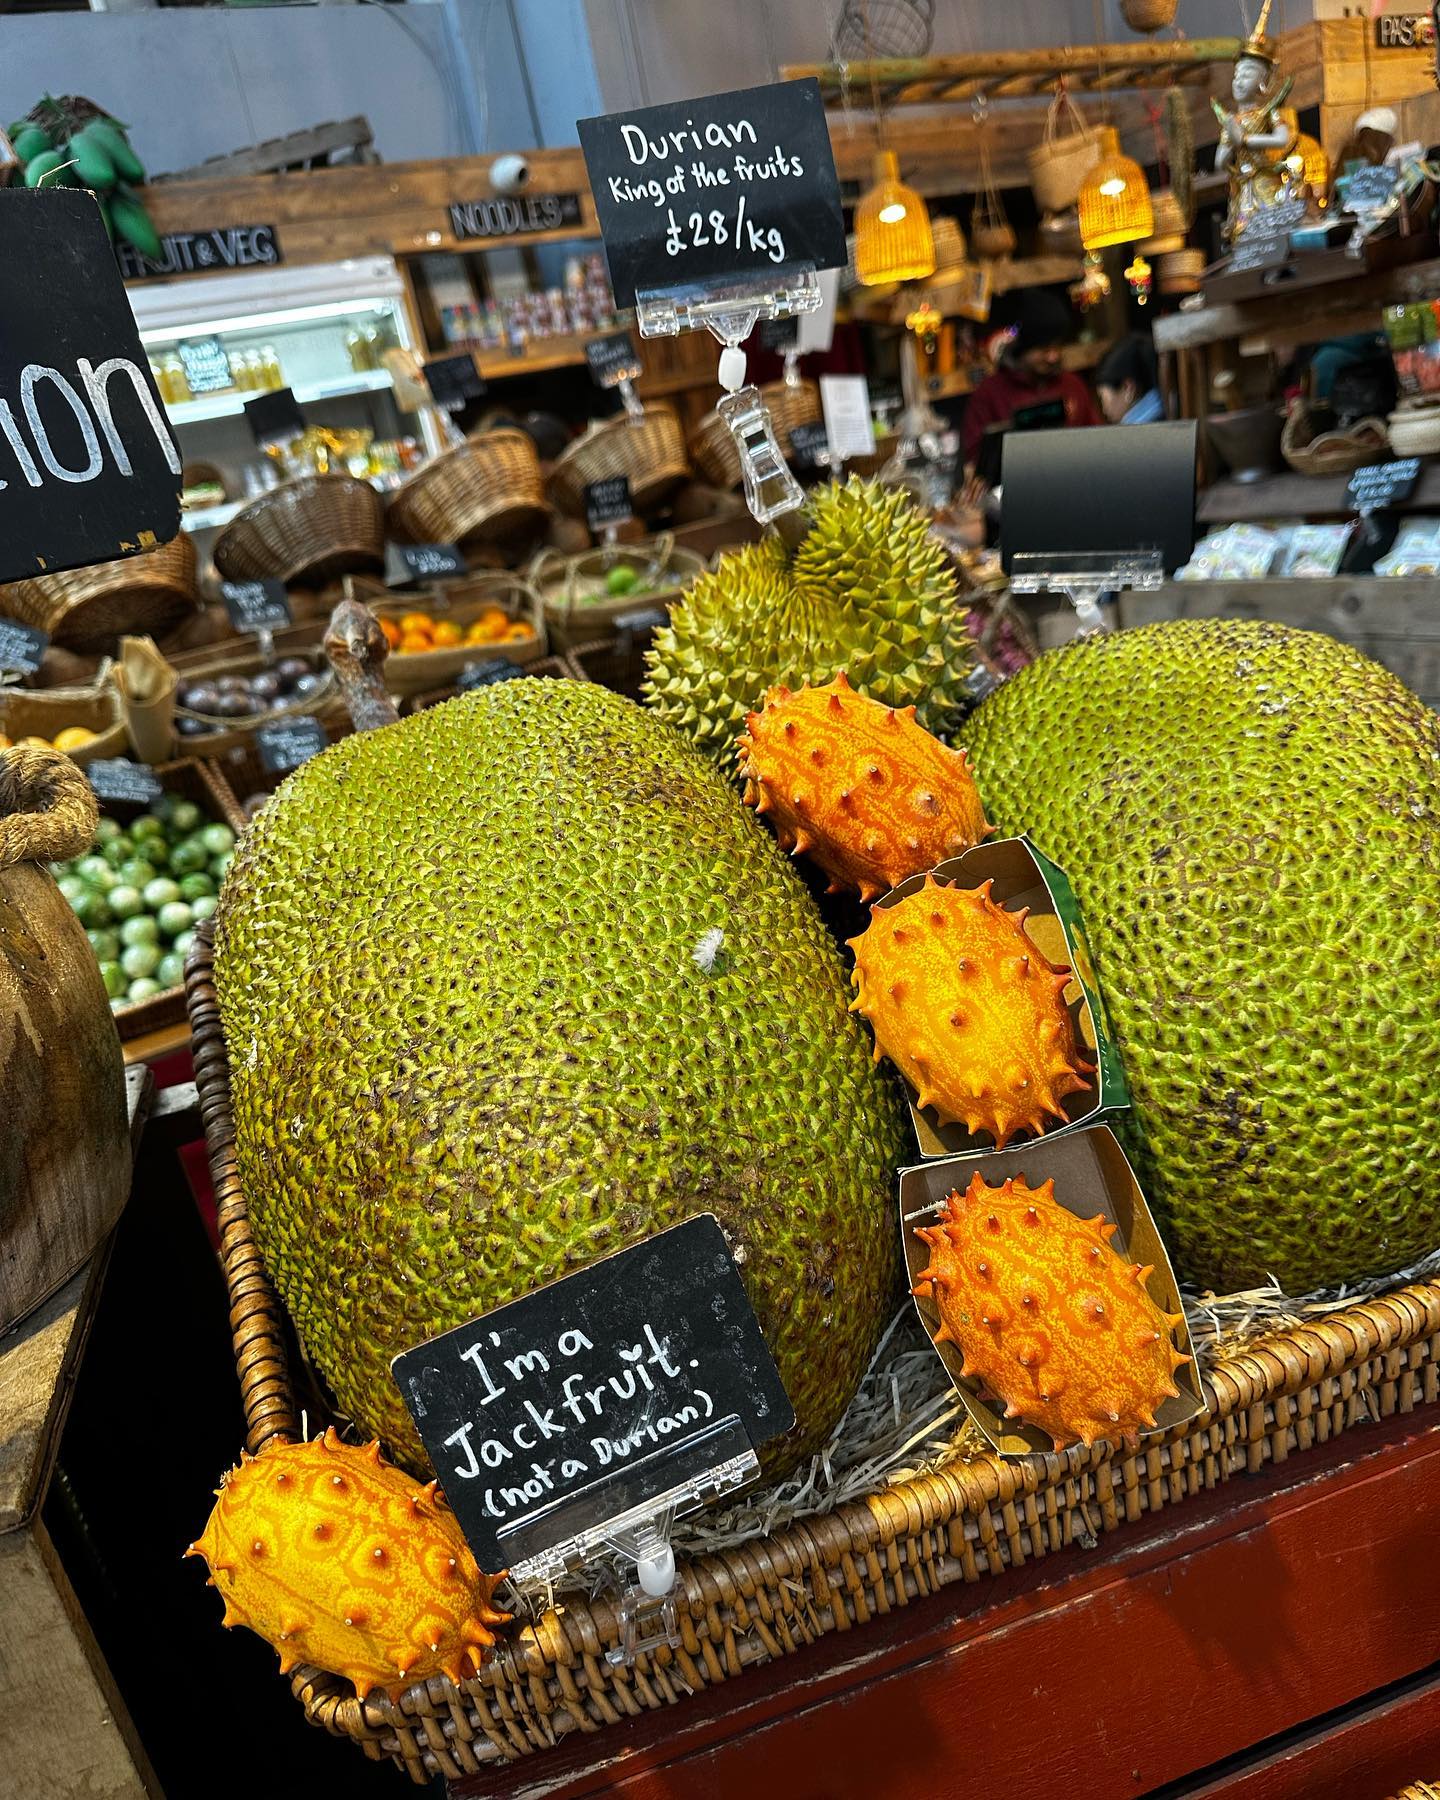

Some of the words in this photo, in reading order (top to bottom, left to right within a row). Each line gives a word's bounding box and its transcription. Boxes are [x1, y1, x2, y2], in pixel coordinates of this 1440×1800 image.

[620, 119, 757, 165] Durian
[608, 176, 665, 207] King
[666, 165, 686, 194] of
[691, 162, 731, 188] the
[734, 145, 803, 181] fruits
[194, 238, 219, 267] &
[211, 224, 278, 266] VEG
[450, 195, 563, 240] NOODLES
[666, 196, 785, 263] £28/kg
[460, 1332, 550, 1405] I'm
[558, 1329, 593, 1356] a
[444, 1324, 699, 1479] Jackfruit.
[484, 1463, 555, 1517] (not
[561, 1459, 588, 1477] a
[590, 1389, 713, 1465] Durian)
